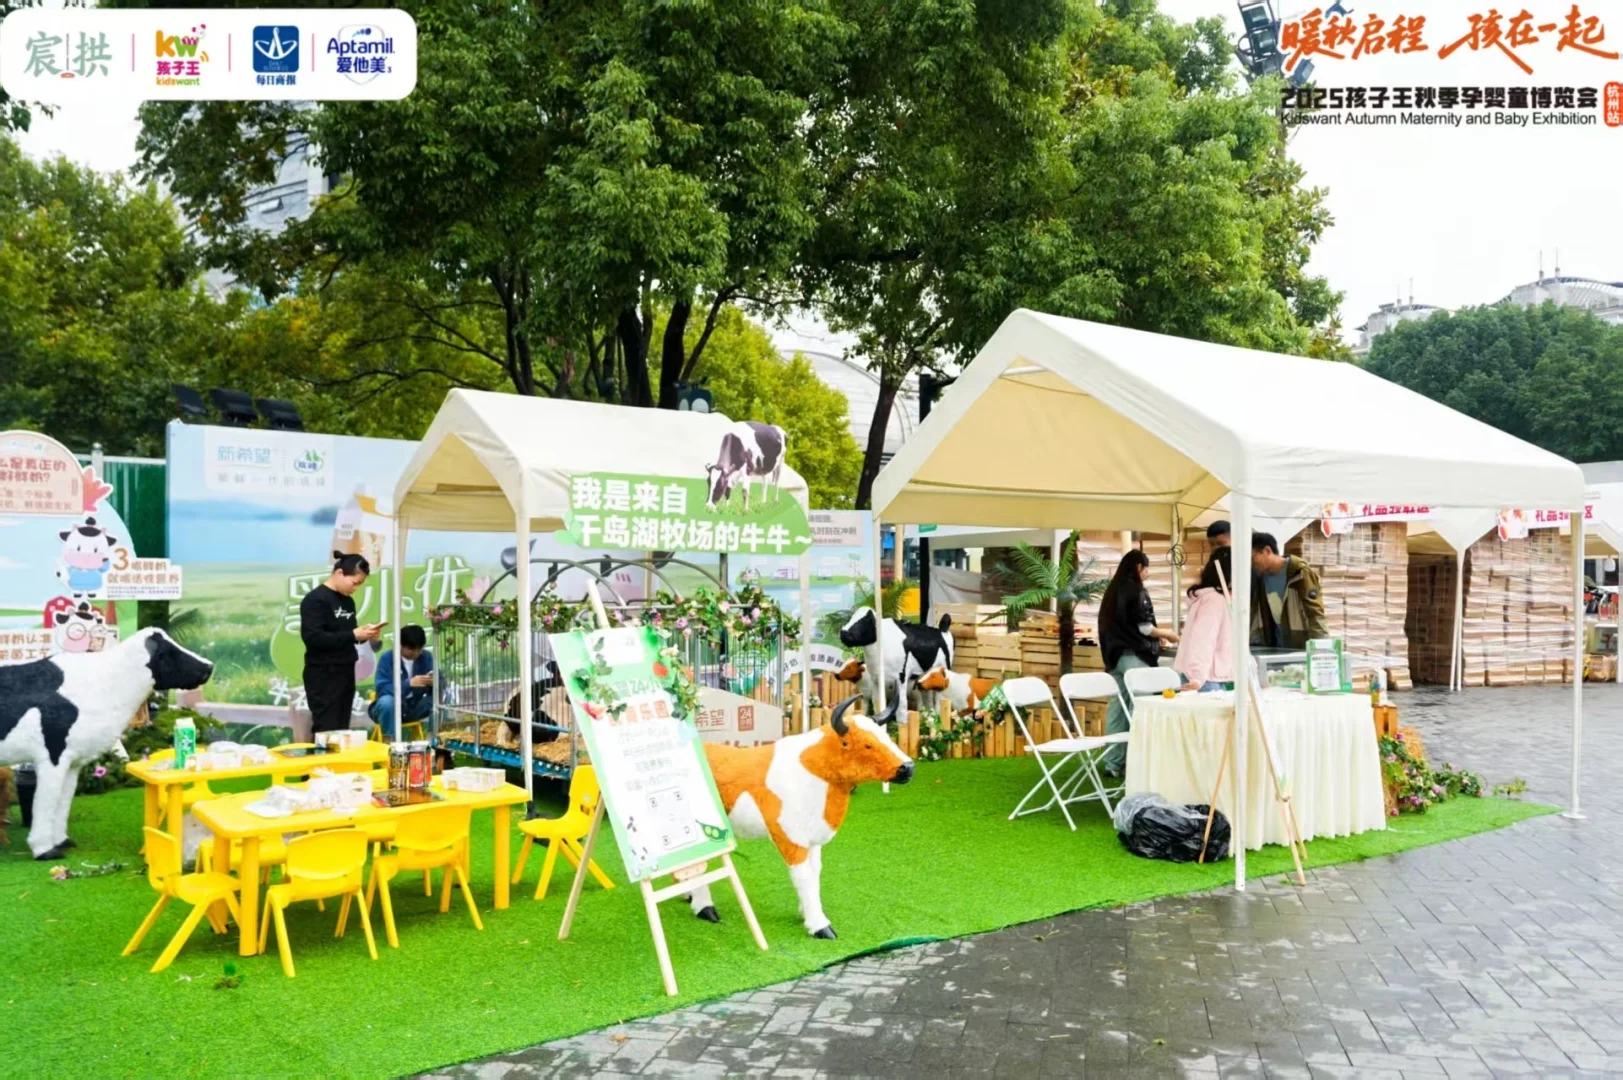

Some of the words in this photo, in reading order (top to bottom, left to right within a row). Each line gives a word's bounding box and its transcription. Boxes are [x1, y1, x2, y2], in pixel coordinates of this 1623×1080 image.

[217, 446, 271, 464] 新希望
[572, 477, 688, 515] 我是来自
[112, 548, 129, 571] 3
